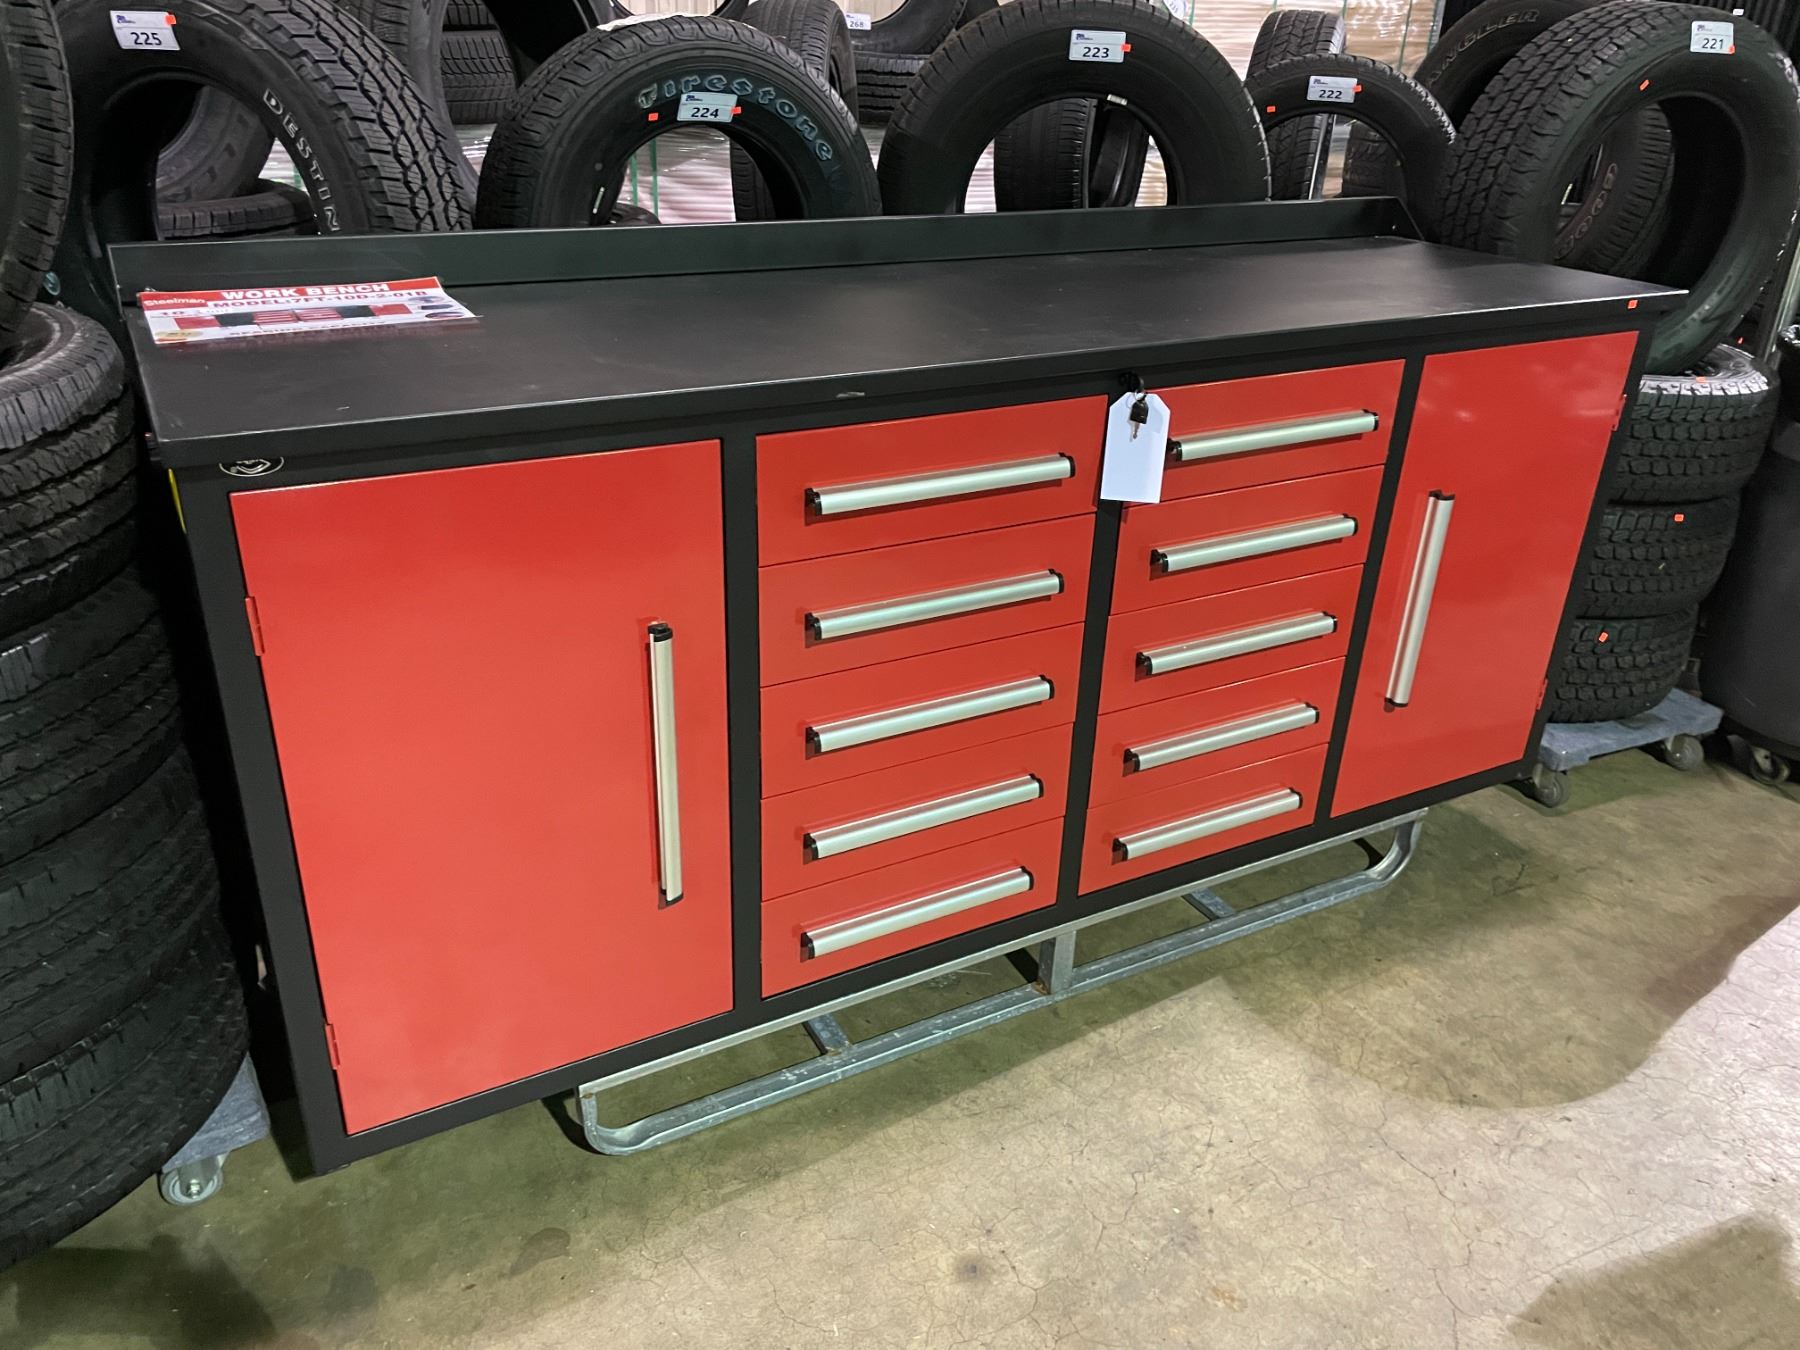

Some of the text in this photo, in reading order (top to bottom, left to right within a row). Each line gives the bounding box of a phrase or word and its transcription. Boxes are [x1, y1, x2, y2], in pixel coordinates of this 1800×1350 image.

[130, 31, 162, 46] 225
[1701, 37, 1724, 50] 221
[1082, 46, 1110, 59] 223
[1318, 89, 1343, 100] 222
[638, 74, 833, 161] Firestone
[690, 107, 720, 119] 224
[220, 282, 390, 300] WORK BENCH
[143, 297, 207, 307] Steelman
